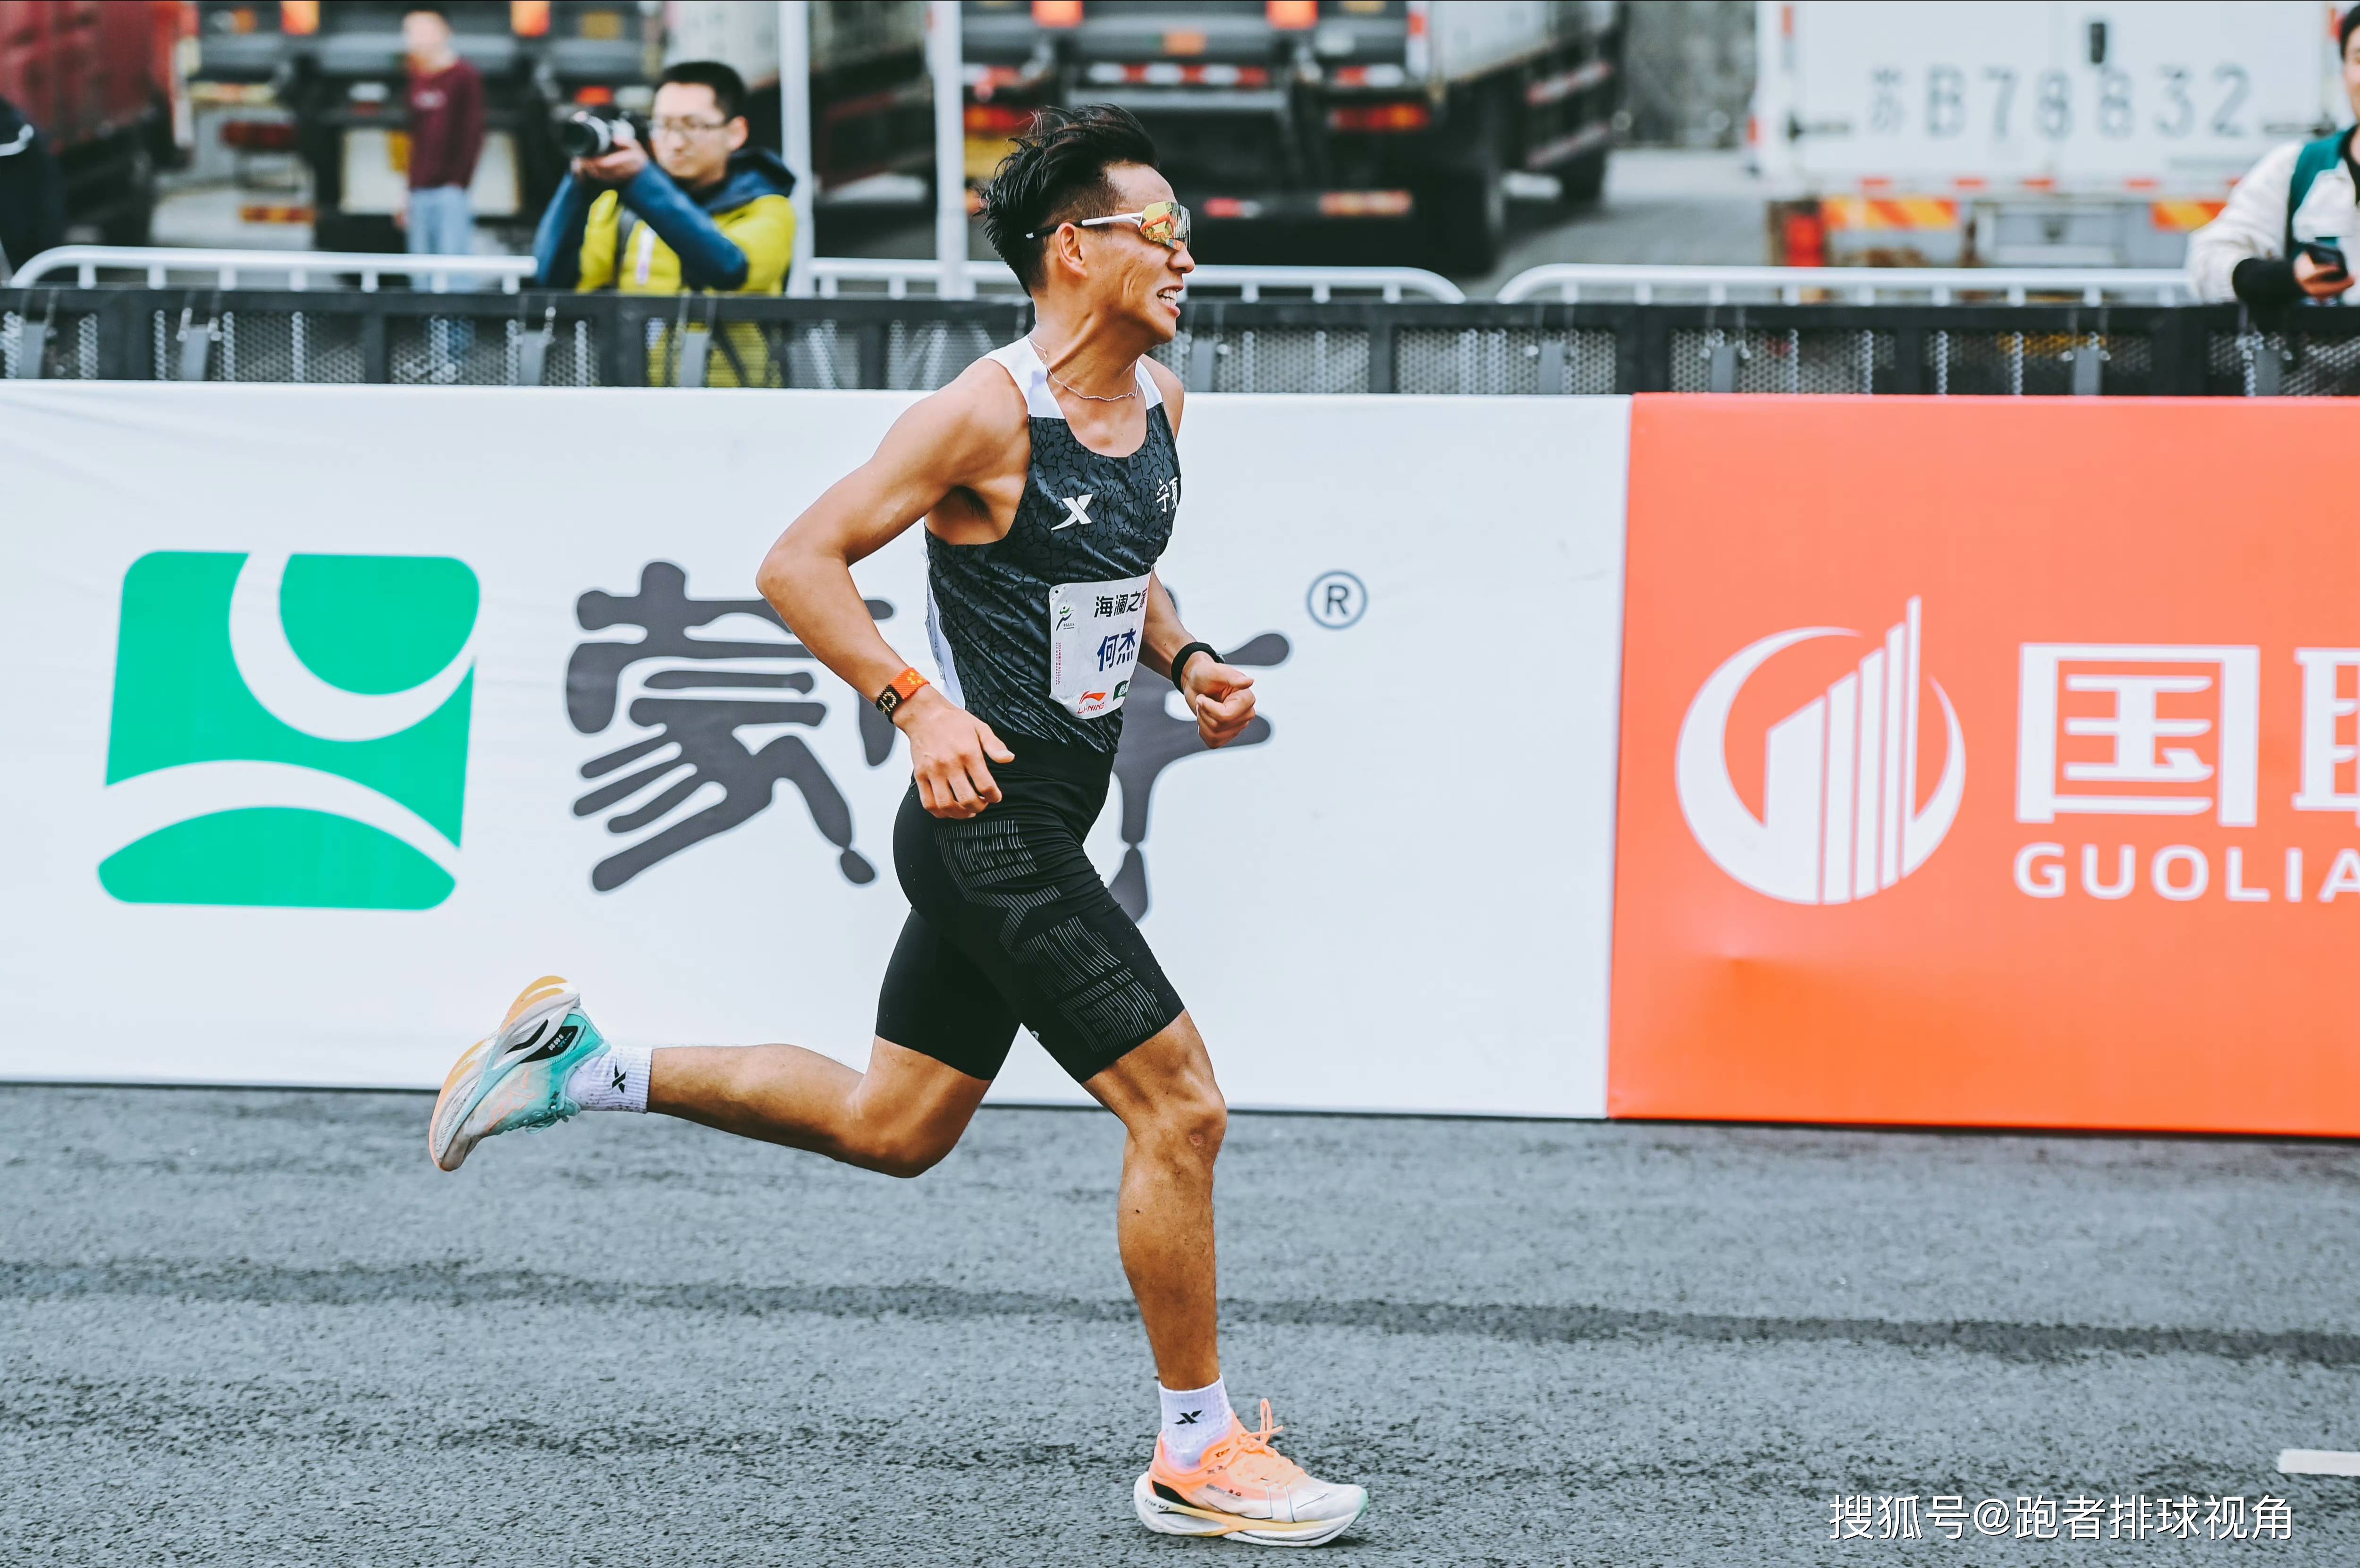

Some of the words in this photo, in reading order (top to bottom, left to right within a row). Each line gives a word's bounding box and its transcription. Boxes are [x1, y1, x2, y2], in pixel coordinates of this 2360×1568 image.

[1156, 477, 1178, 512] 宁夏
[1097, 628, 1137, 672] 何杰
[2015, 641, 2360, 827] 国
[2014, 842, 2360, 902] GUOLIA
